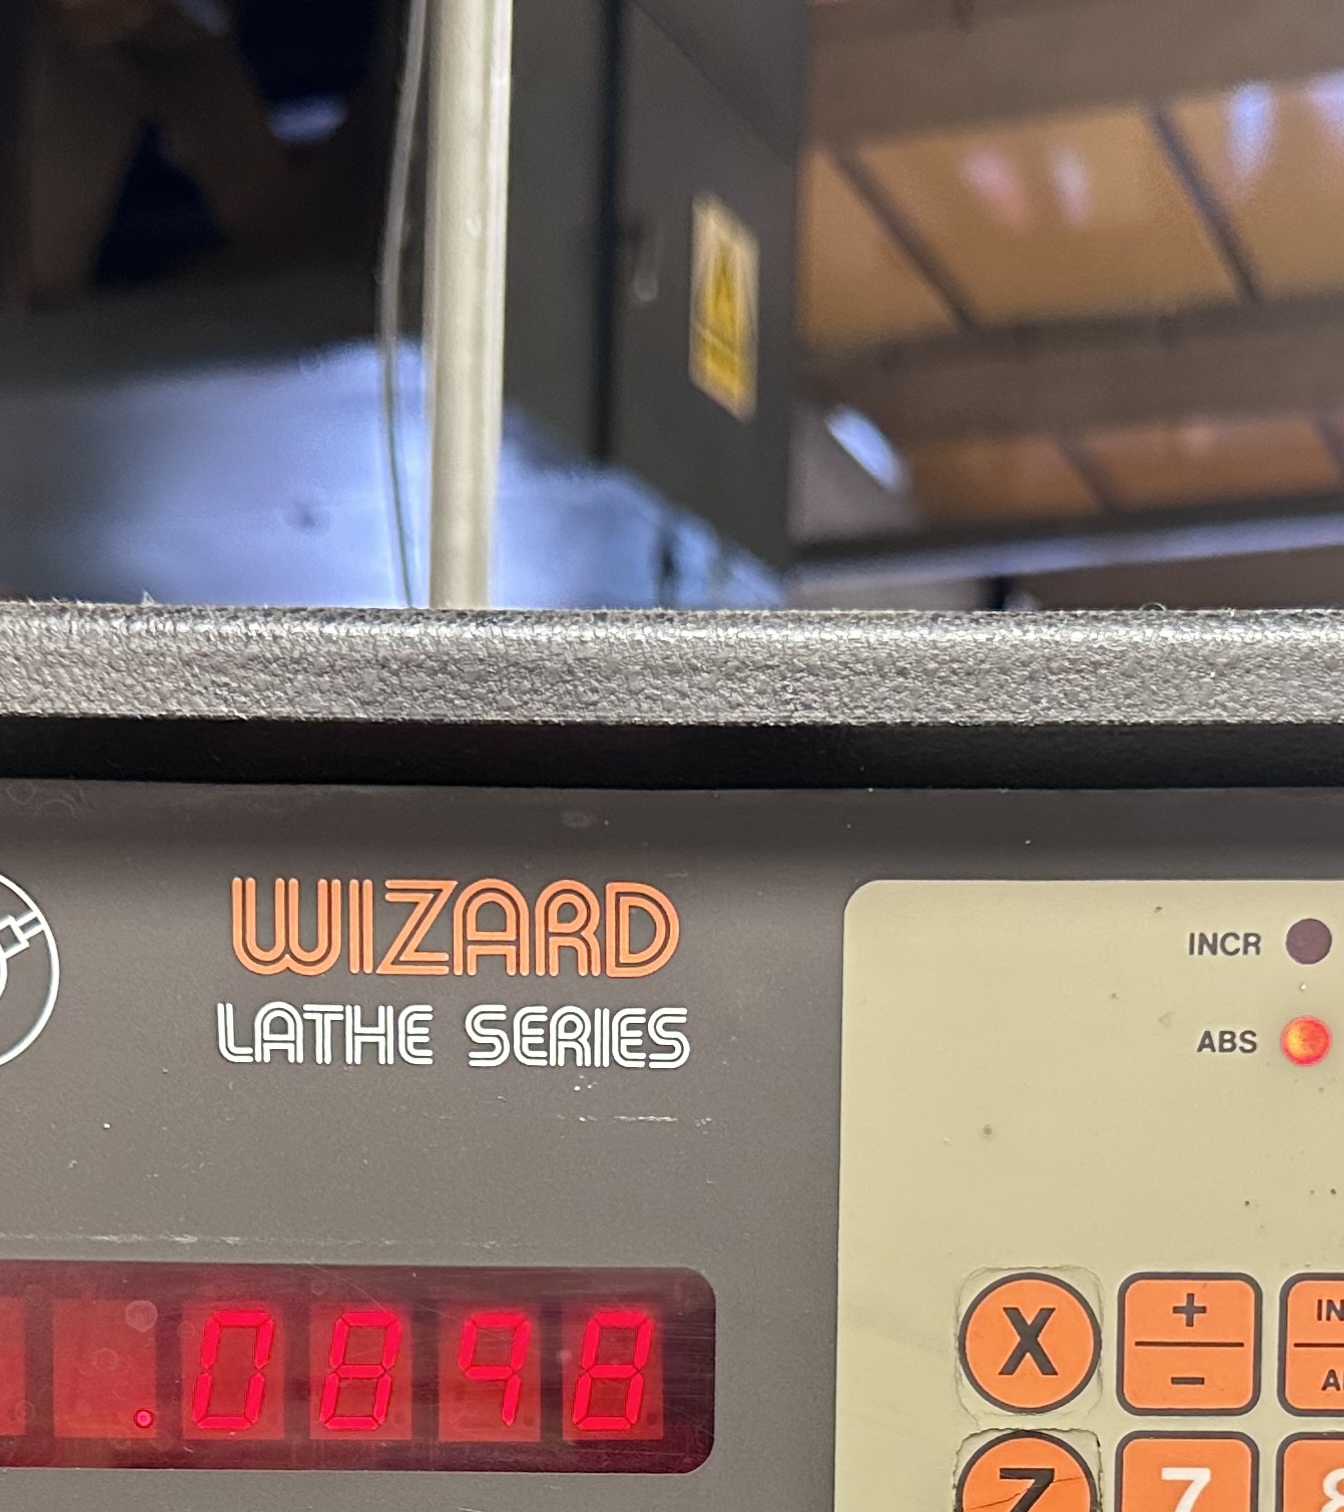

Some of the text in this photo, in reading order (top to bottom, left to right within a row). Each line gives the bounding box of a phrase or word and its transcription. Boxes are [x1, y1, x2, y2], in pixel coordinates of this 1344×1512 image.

[232, 878, 680, 978] WIZARD
[1187, 931, 1263, 958] INCR
[216, 1001, 690, 1069] LATHE SERIES
[1195, 1028, 1259, 1055] ABS
[997, 1305, 1060, 1377] X
